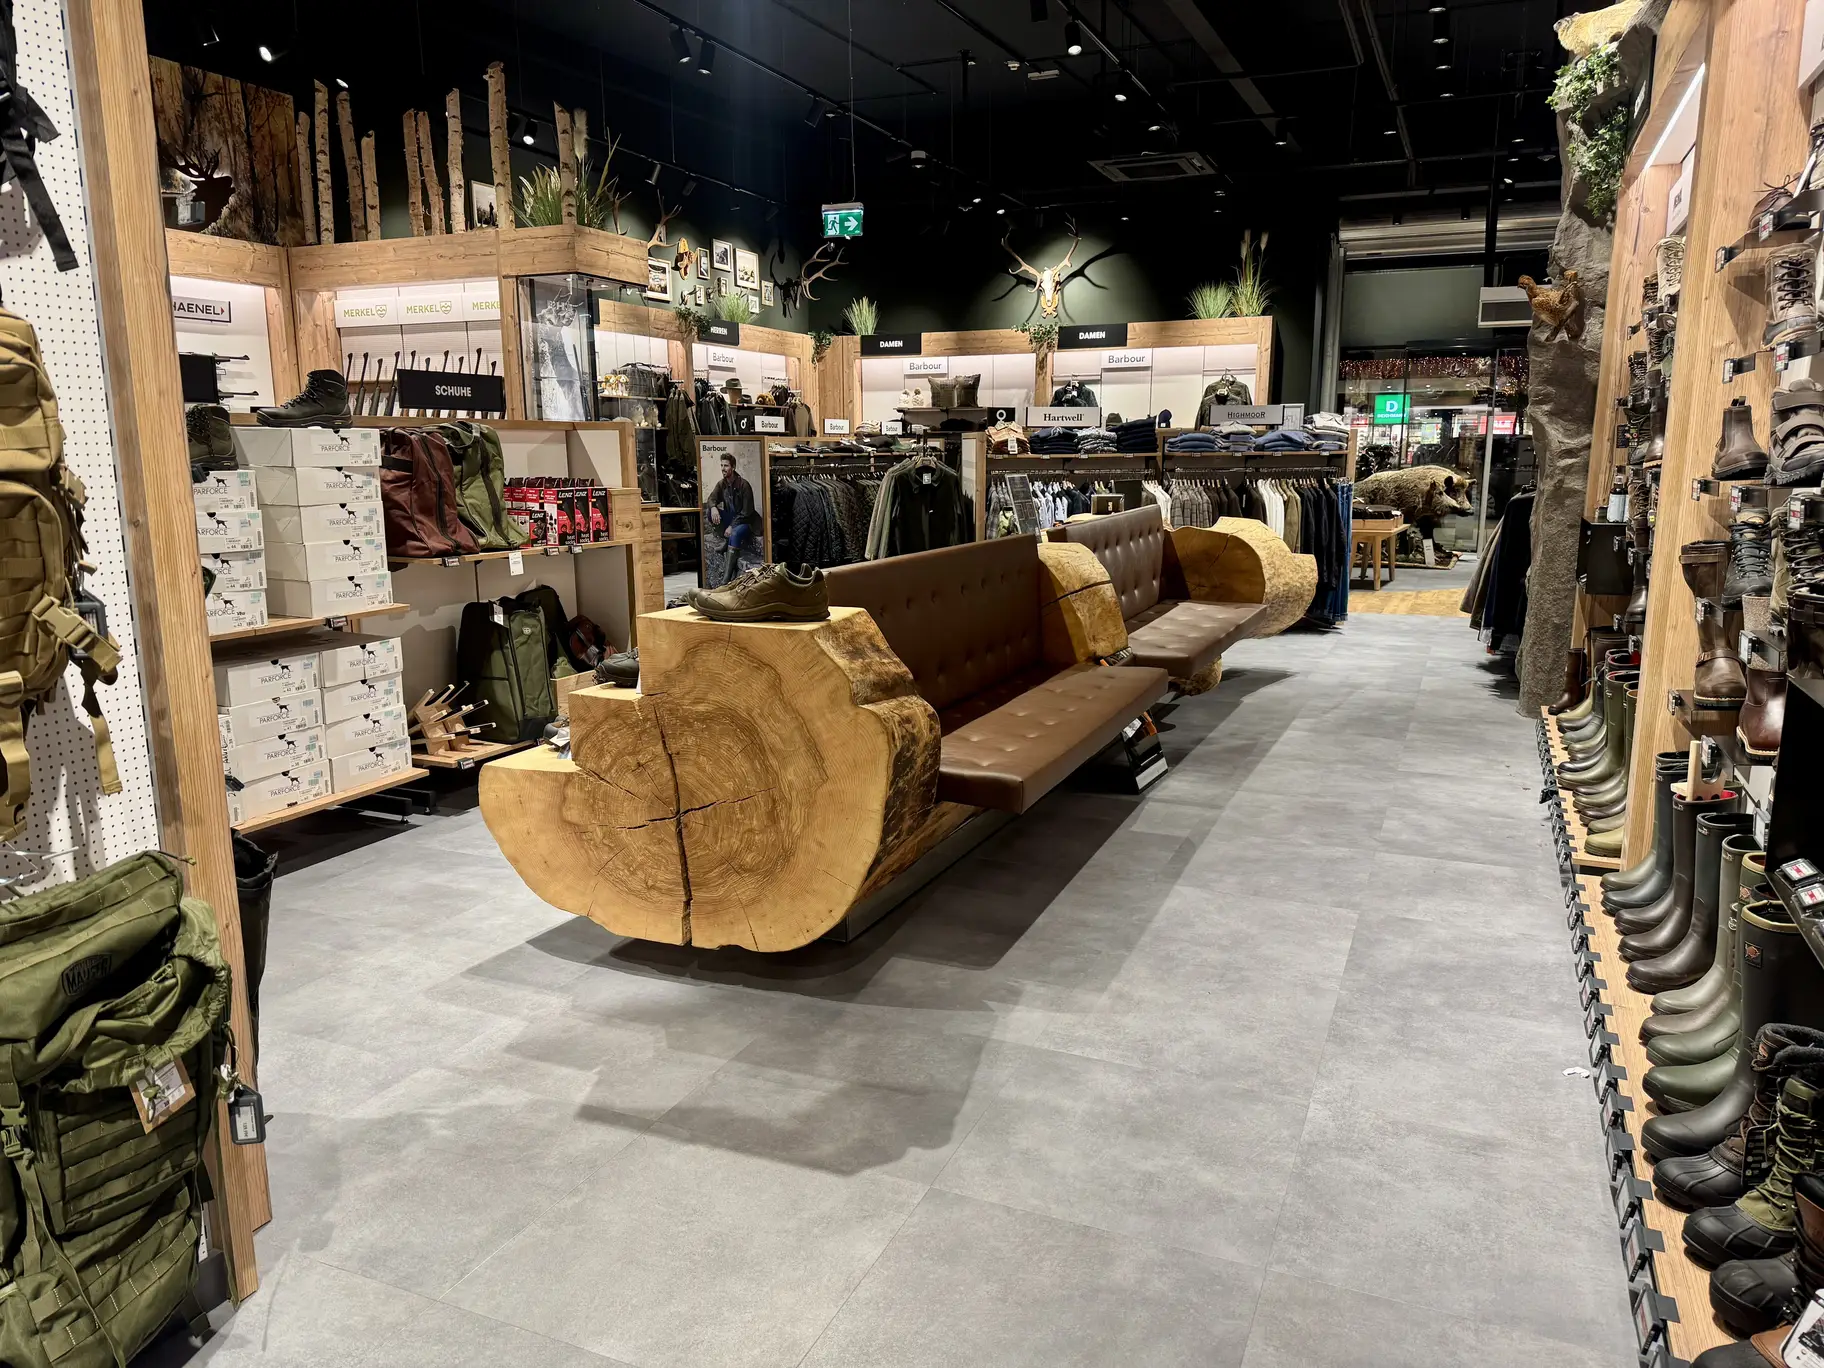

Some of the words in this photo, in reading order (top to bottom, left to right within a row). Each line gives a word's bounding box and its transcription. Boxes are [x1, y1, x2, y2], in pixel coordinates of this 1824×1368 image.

[406, 304, 440, 314] MERKEL
[472, 301, 500, 310] MERKE
[343, 308, 375, 318] MERKEL
[710, 326, 727, 335] HERREN
[1078, 331, 1106, 340] DAMEN
[880, 340, 903, 348] DAMEN
[713, 352, 734, 363] Barbour
[1108, 354, 1145, 364] Barbour
[909, 362, 942, 372] Barbour
[435, 385, 472, 398] SCHUHE
[1386, 400, 1398, 413] D
[761, 420, 778, 429] Barbour
[830, 422, 844, 431] Barbour
[885, 424, 898, 433] Barbour
[350, 658, 376, 667] PARFORCE
[261, 673, 291, 684] PARFORCE
[351, 692, 377, 702] PARFORCE
[260, 712, 289, 724] PARFORCE
[354, 726, 382, 737] PARFORCE
[267, 747, 297, 759] PARFORCE
[359, 760, 385, 772] PARFORCE
[270, 784, 300, 797] PARFORCE
